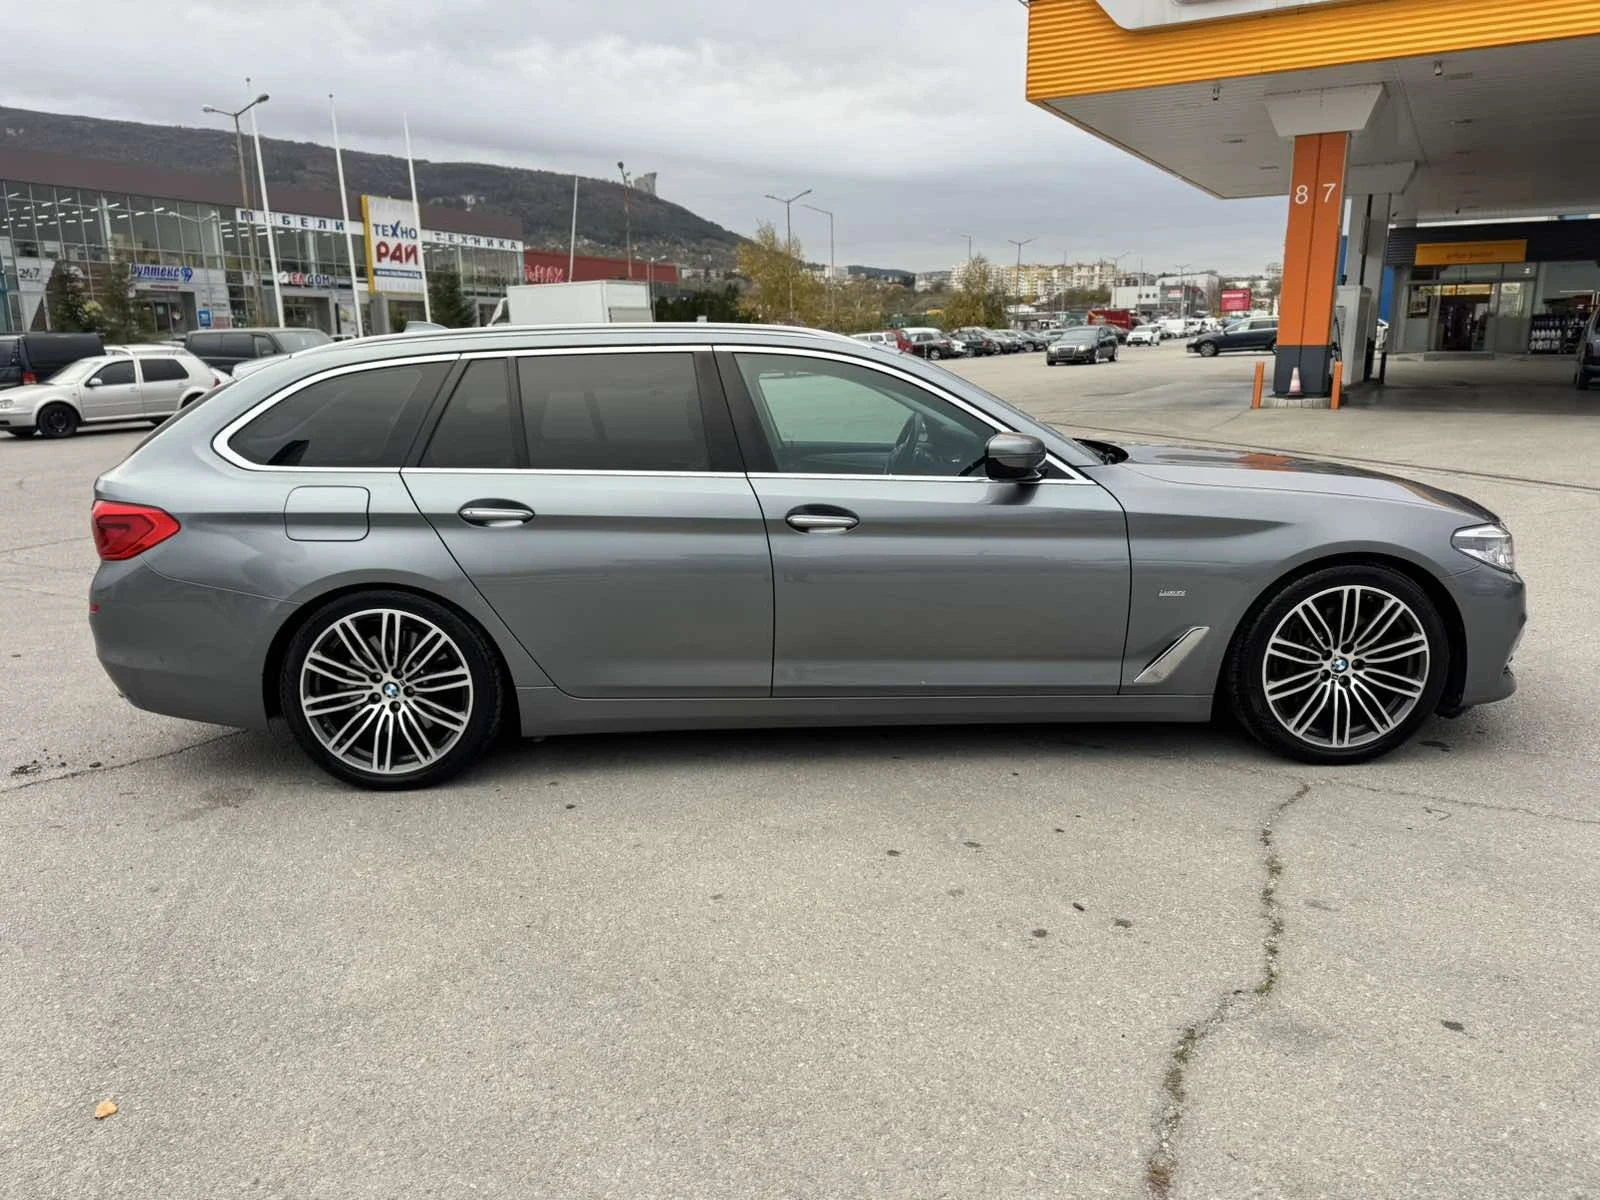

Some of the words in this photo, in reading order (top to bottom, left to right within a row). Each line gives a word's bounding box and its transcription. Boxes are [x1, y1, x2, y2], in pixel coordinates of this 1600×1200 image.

[1295, 184, 1308, 205] 8
[1323, 183, 1336, 203] 7
[373, 220, 418, 239] ТЕХНО
